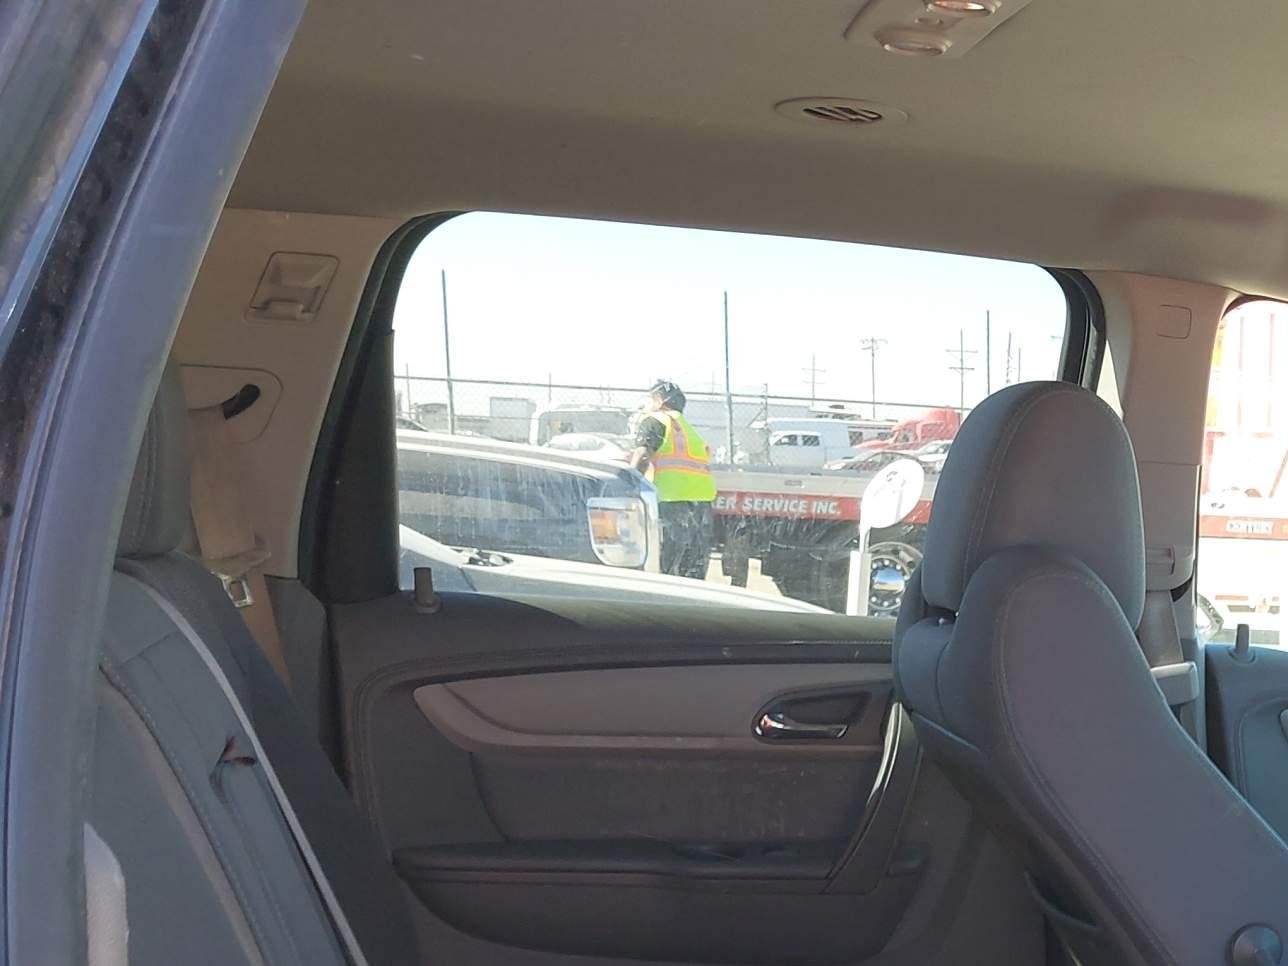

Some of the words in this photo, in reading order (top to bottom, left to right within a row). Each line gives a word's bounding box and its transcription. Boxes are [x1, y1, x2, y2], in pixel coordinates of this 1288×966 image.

[712, 497, 736, 510] ER
[743, 498, 808, 513] SERVICE
[813, 501, 841, 515] INC.
